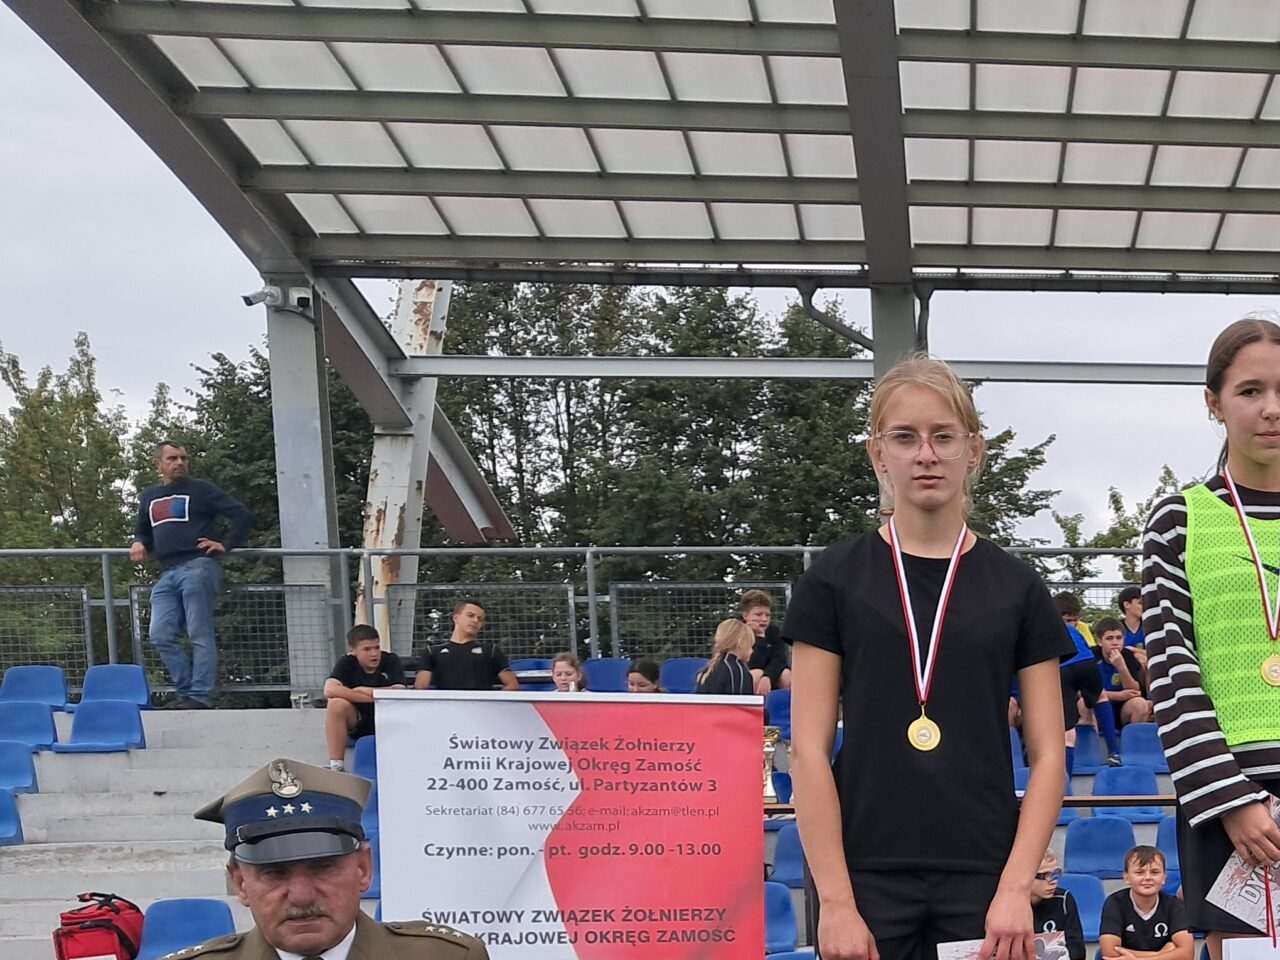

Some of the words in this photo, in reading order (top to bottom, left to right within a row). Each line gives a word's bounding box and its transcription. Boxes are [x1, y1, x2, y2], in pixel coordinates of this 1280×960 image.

[449, 734, 534, 753] Światowy
[539, 737, 609, 753] Związek
[614, 735, 695, 754] Żołnierzy
[443, 757, 491, 770] Armii
[496, 757, 572, 774] Krajowej
[578, 758, 630, 774] Okręg
[636, 758, 702, 772] Zamość
[427, 778, 488, 791] 22-400
[493, 778, 565, 792] Zamość,
[569, 778, 590, 792] ul.
[594, 778, 703, 794] Partyzantów
[708, 779, 717, 792] 3
[425, 805, 493, 816] Sekretariat
[496, 805, 520, 817] (84)
[523, 805, 546, 816] 677
[549, 805, 564, 816] 65
[528, 821, 620, 834] www.akzam.pl
[424, 843, 493, 859] Czynne:
[497, 845, 535, 859] pon.
[549, 845, 571, 858] pt.
[579, 843, 626, 859] godz.
[628, 844, 664, 856] 9.00
[422, 908, 525, 924] ŚWIATOWY
[531, 909, 615, 925] ZWIĄZEK
[622, 906, 726, 922] ŻOŁNIERZY
[475, 931, 578, 945] KRAJOWEJ
[585, 931, 650, 946] OKRĘG
[657, 926, 736, 943] ZAMOŚĆ
